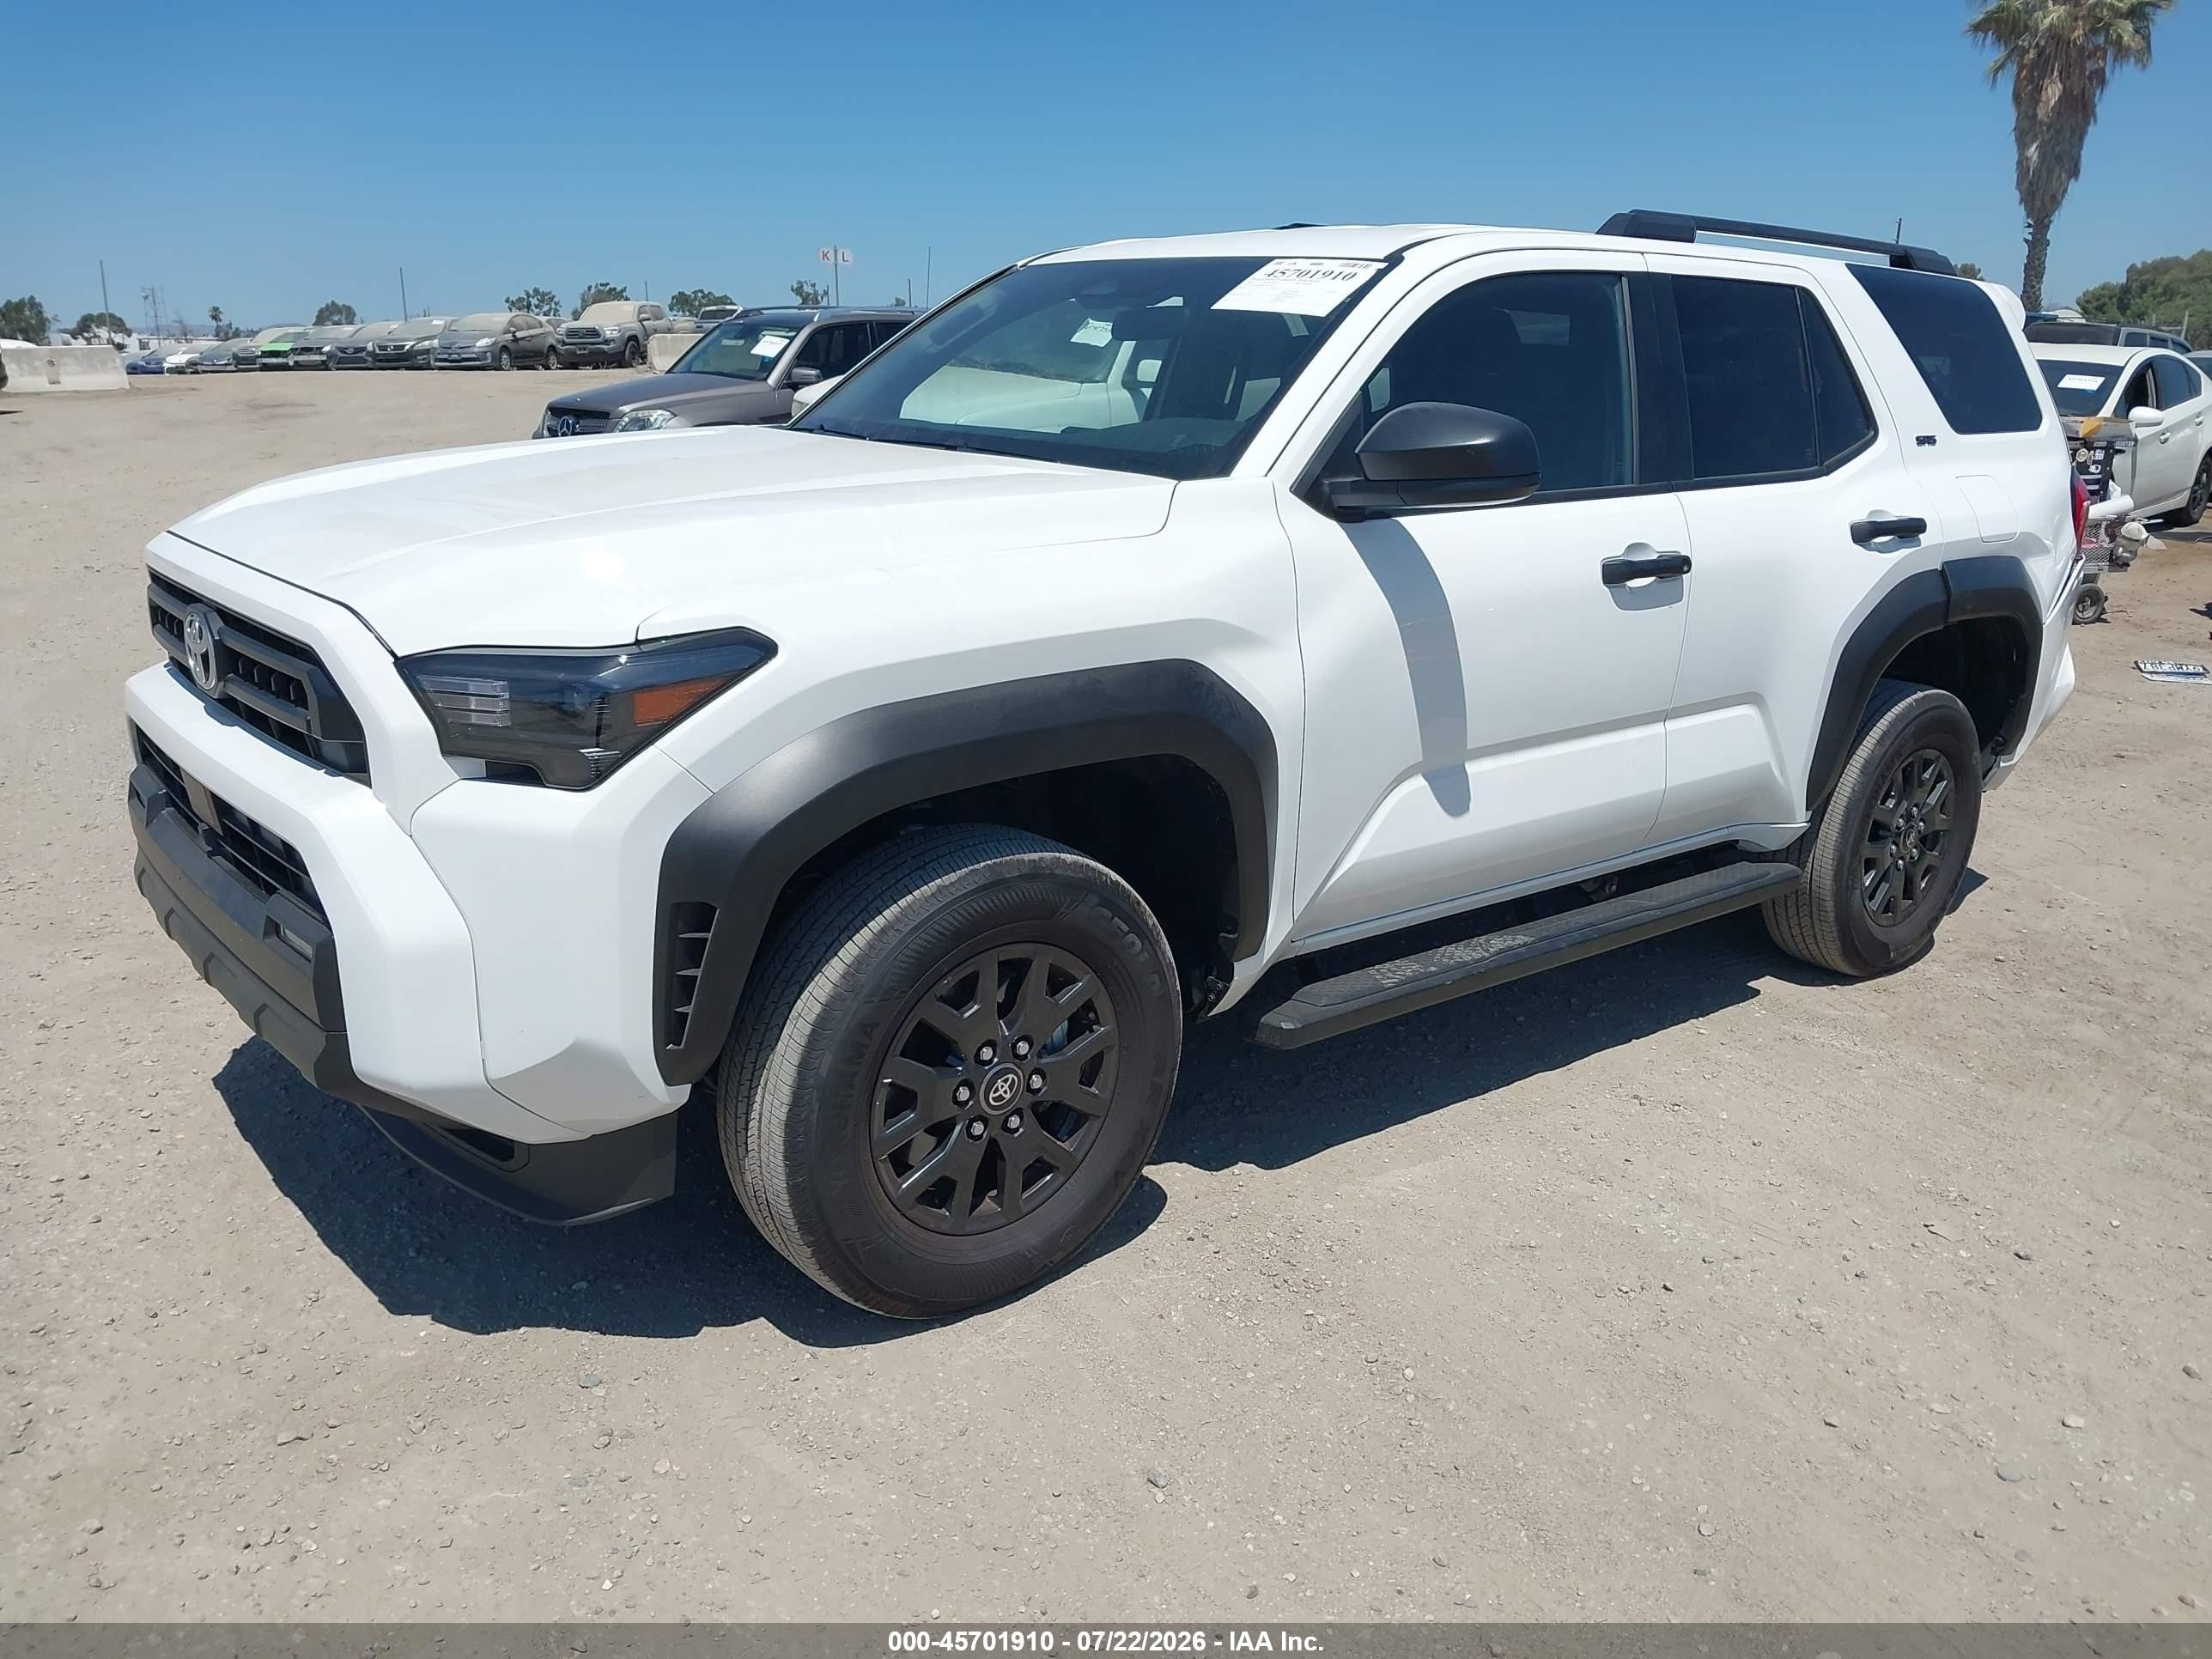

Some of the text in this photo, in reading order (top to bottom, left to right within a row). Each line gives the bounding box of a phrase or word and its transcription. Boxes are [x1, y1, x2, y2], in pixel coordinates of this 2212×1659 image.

[821, 250, 831, 262] K
[842, 251, 850, 263] L
[1264, 268, 1358, 282] 45701910
